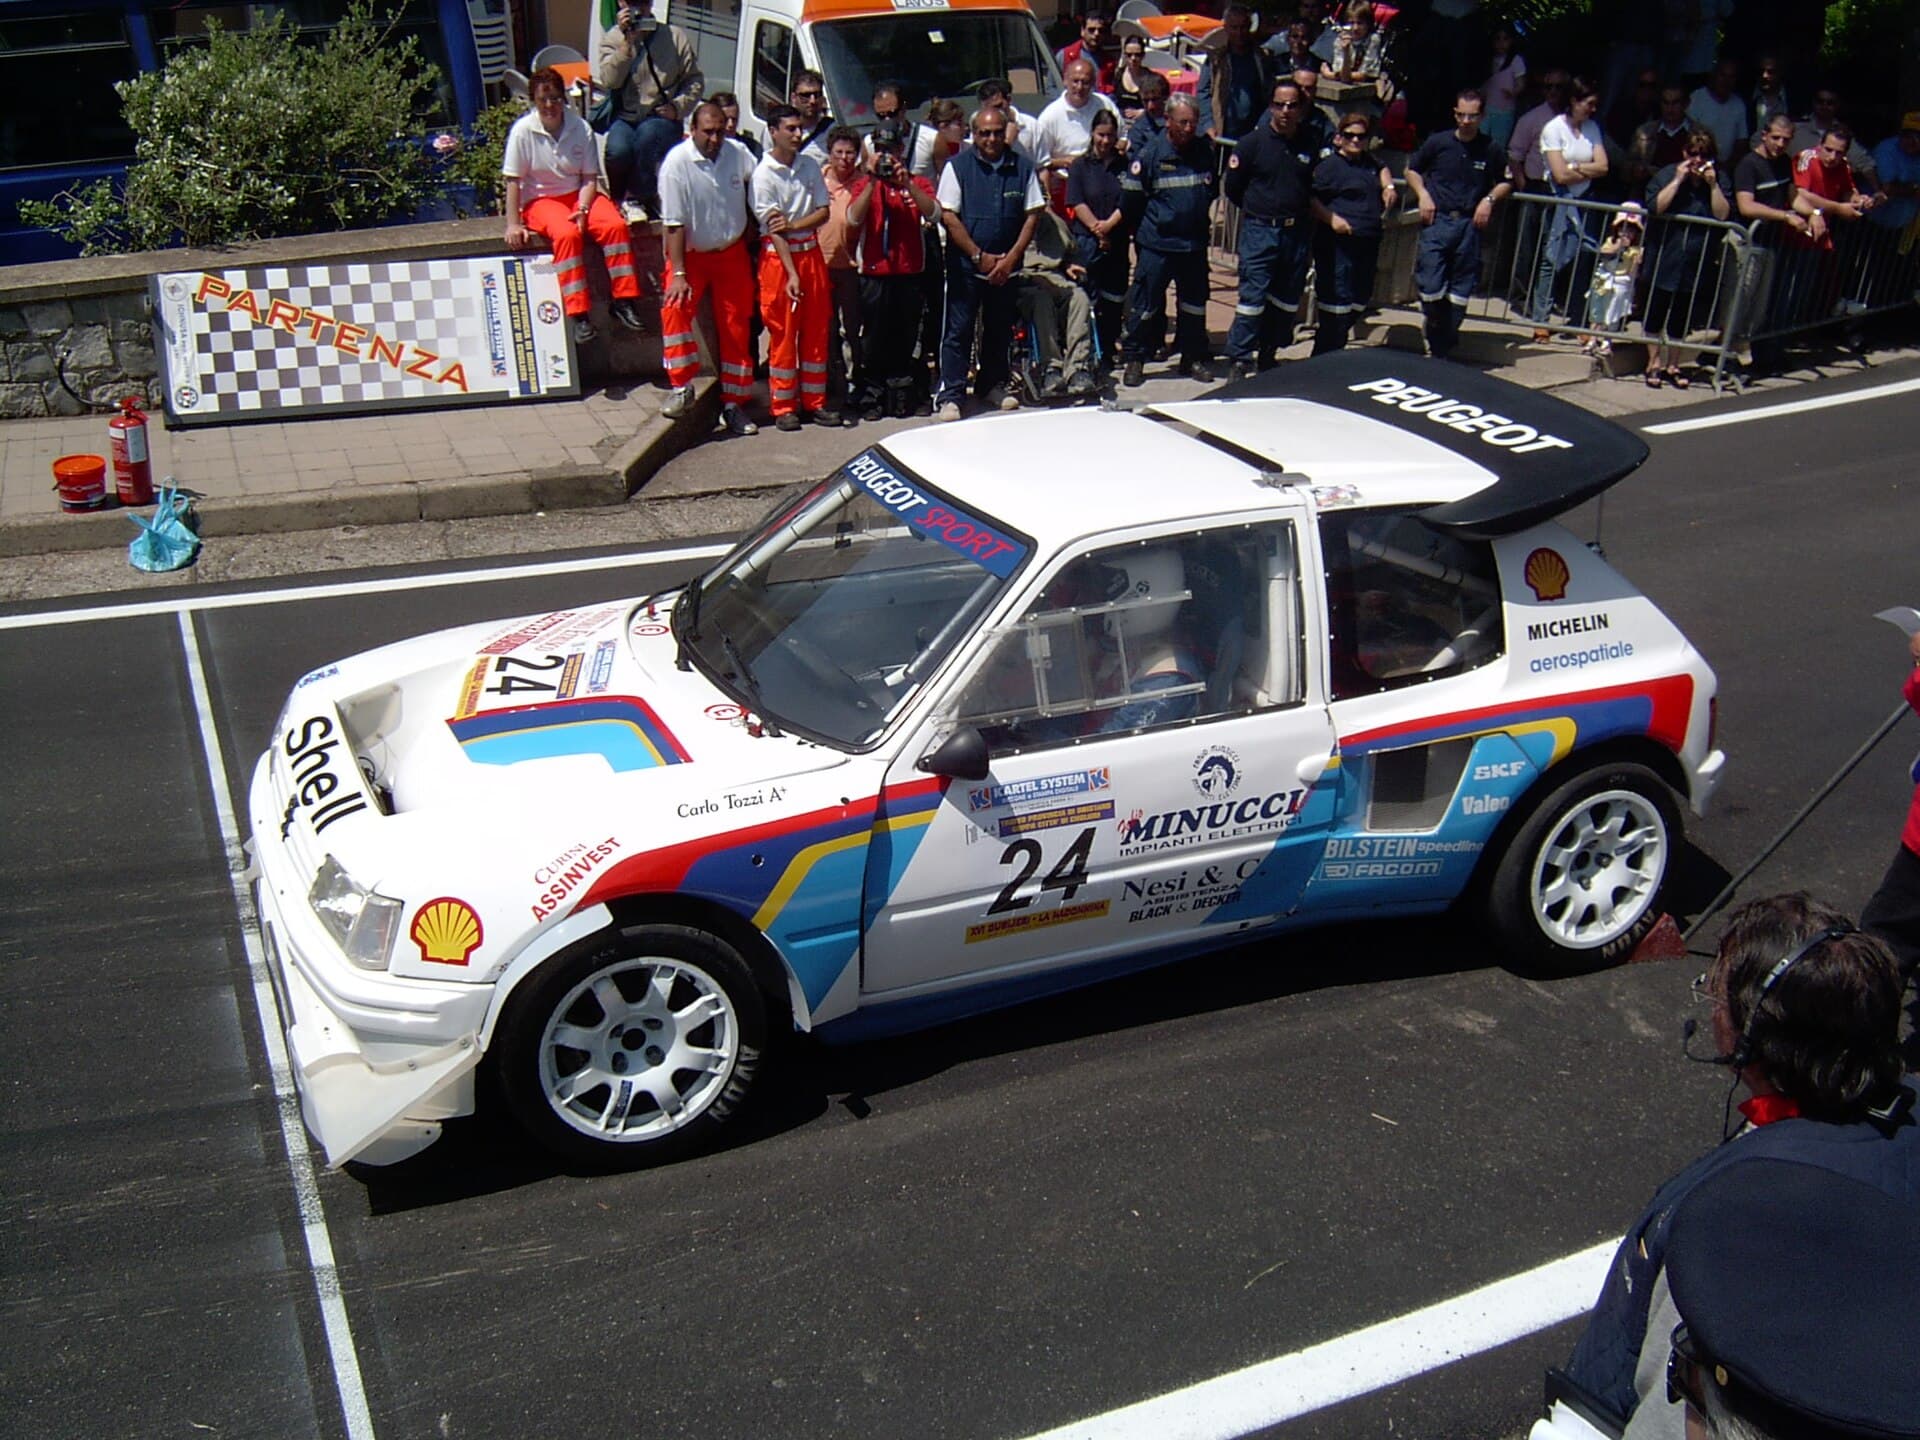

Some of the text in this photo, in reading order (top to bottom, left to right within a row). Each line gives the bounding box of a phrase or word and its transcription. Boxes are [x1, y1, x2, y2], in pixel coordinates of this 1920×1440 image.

[197, 275, 469, 392] PARTENZA
[1348, 378, 1574, 453] PEUGEOT
[848, 455, 1015, 560] PEUGEOT SPORT
[1528, 613, 1609, 641] MICHELIN
[486, 655, 565, 695] 24
[1530, 641, 1633, 673] aerospatiale
[286, 716, 368, 836] Shell
[993, 781, 1039, 798] KARTEL
[1041, 773, 1086, 790] SYSTEM
[1473, 761, 1526, 781] SKF
[677, 800, 719, 818] Carlo
[723, 794, 764, 810] Tozzi
[1120, 789, 1304, 846] MINUCCI
[1462, 795, 1509, 815] Valeo
[1120, 818, 1302, 857] IMPIANTI ELETTRICI
[1324, 837, 1484, 859] BILSTEIN speedline
[530, 837, 622, 923] ASSINVEST
[987, 827, 1097, 916] 24
[1121, 871, 1187, 901] Nesi
[1197, 865, 1223, 887] &
[1129, 891, 1242, 923] BLACK & DECKER
